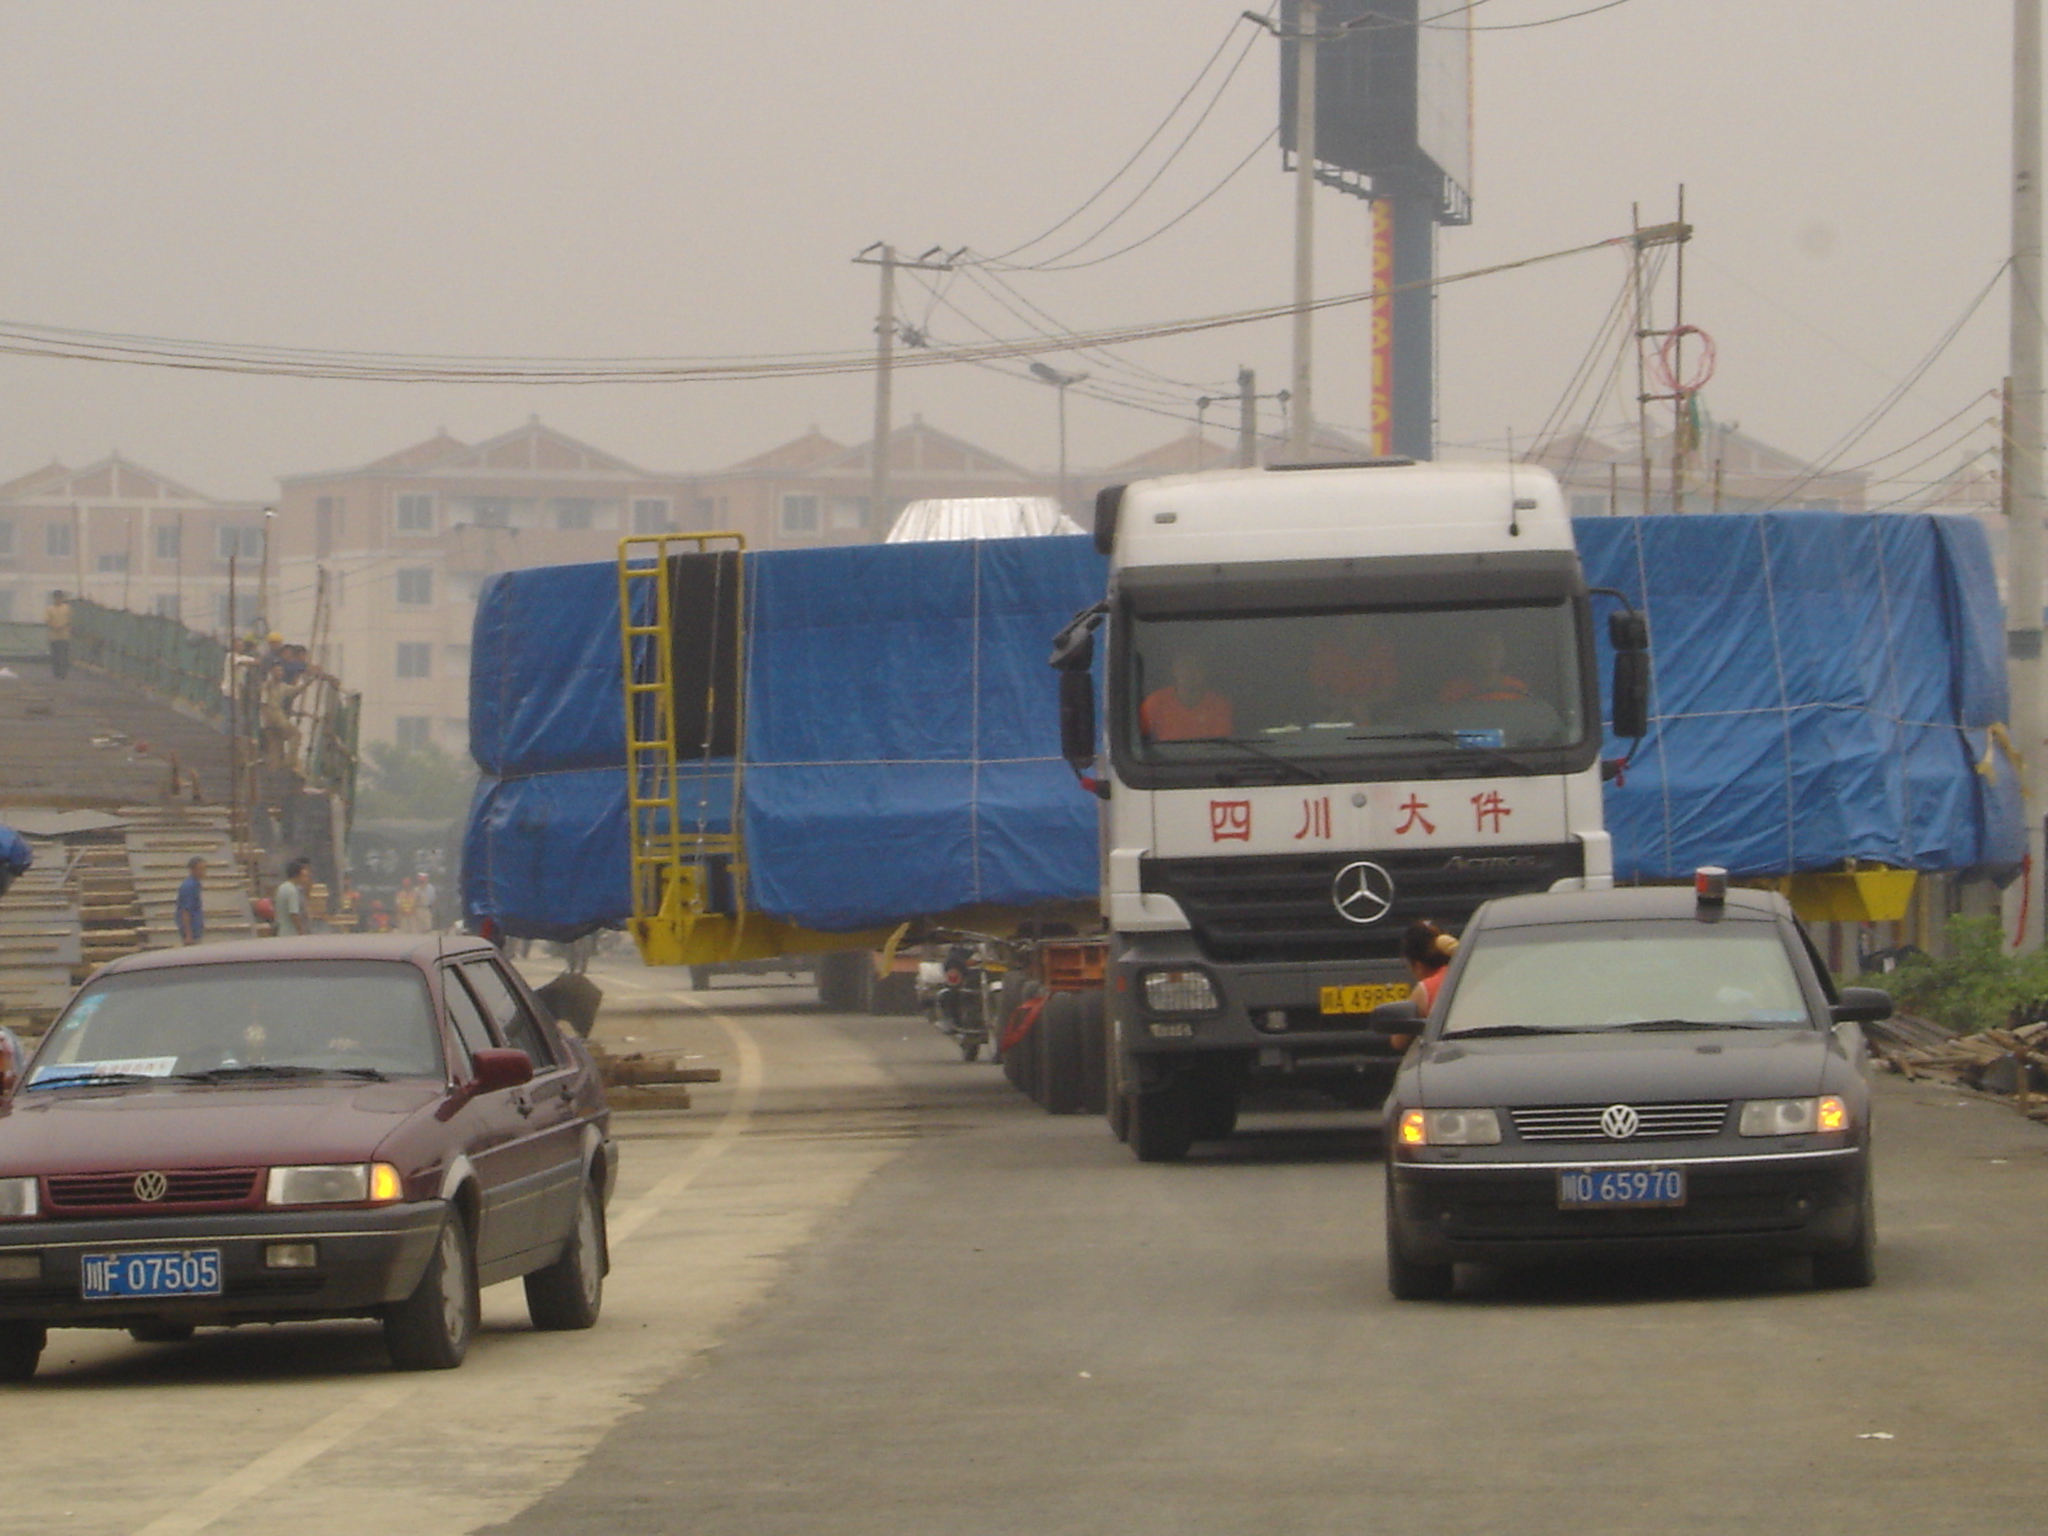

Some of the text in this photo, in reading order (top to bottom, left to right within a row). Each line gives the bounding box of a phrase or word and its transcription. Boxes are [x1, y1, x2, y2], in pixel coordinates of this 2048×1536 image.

[1210, 791, 1512, 842] 四川大件
[1600, 1171, 1681, 1200] 65970
[127, 1256, 217, 1290] 07505
